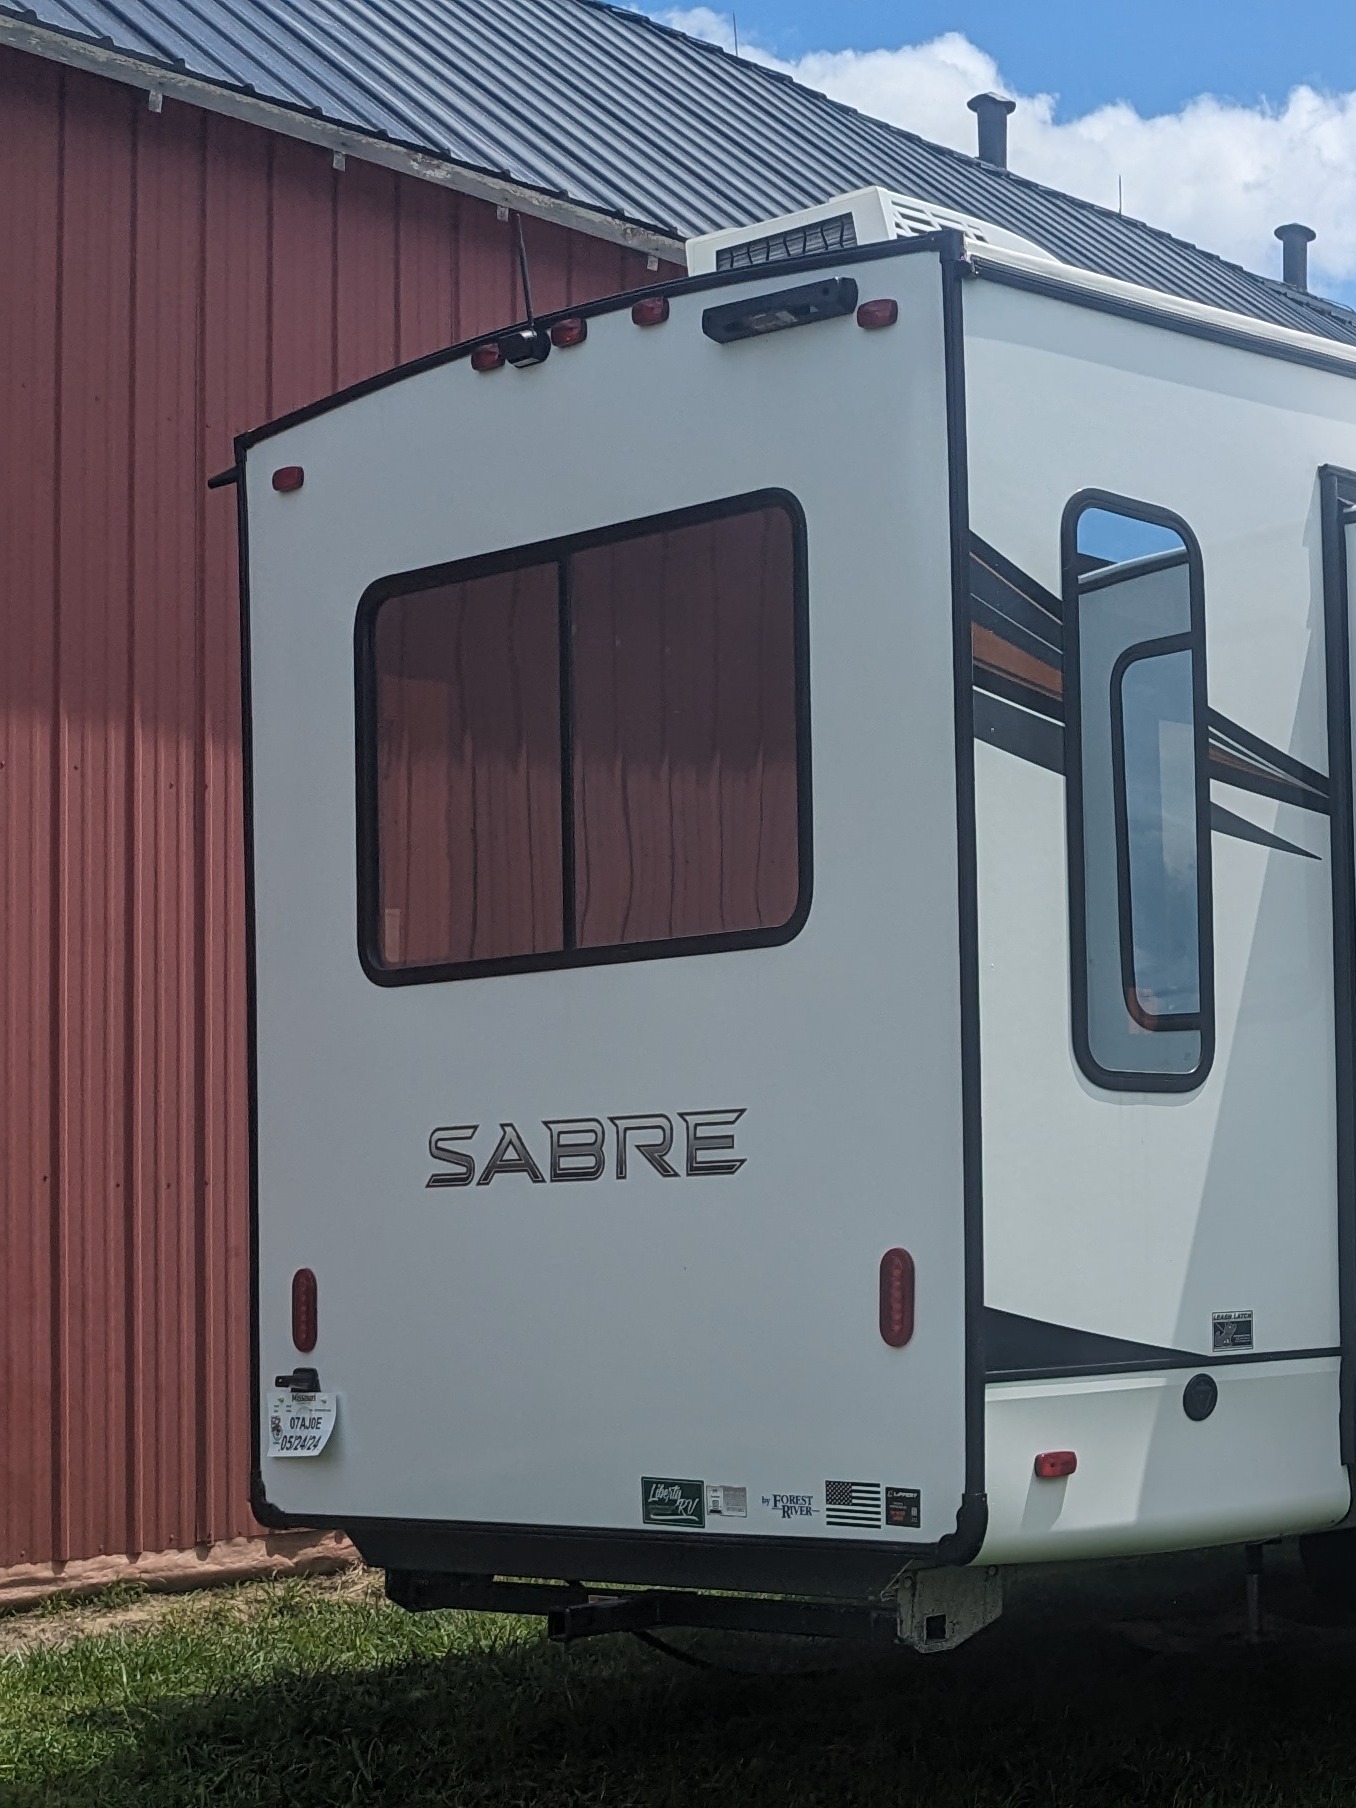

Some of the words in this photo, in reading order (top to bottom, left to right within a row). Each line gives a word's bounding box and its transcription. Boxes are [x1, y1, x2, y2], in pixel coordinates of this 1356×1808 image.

[425, 1108, 747, 1188] SABRE
[280, 1435, 322, 1451] 05/24/24
[648, 1483, 682, 1503] Liberty
[761, 1495, 771, 1506] by
[772, 1494, 814, 1508] FOREST
[675, 1498, 699, 1517] RV
[781, 1504, 813, 1519] RIVER
